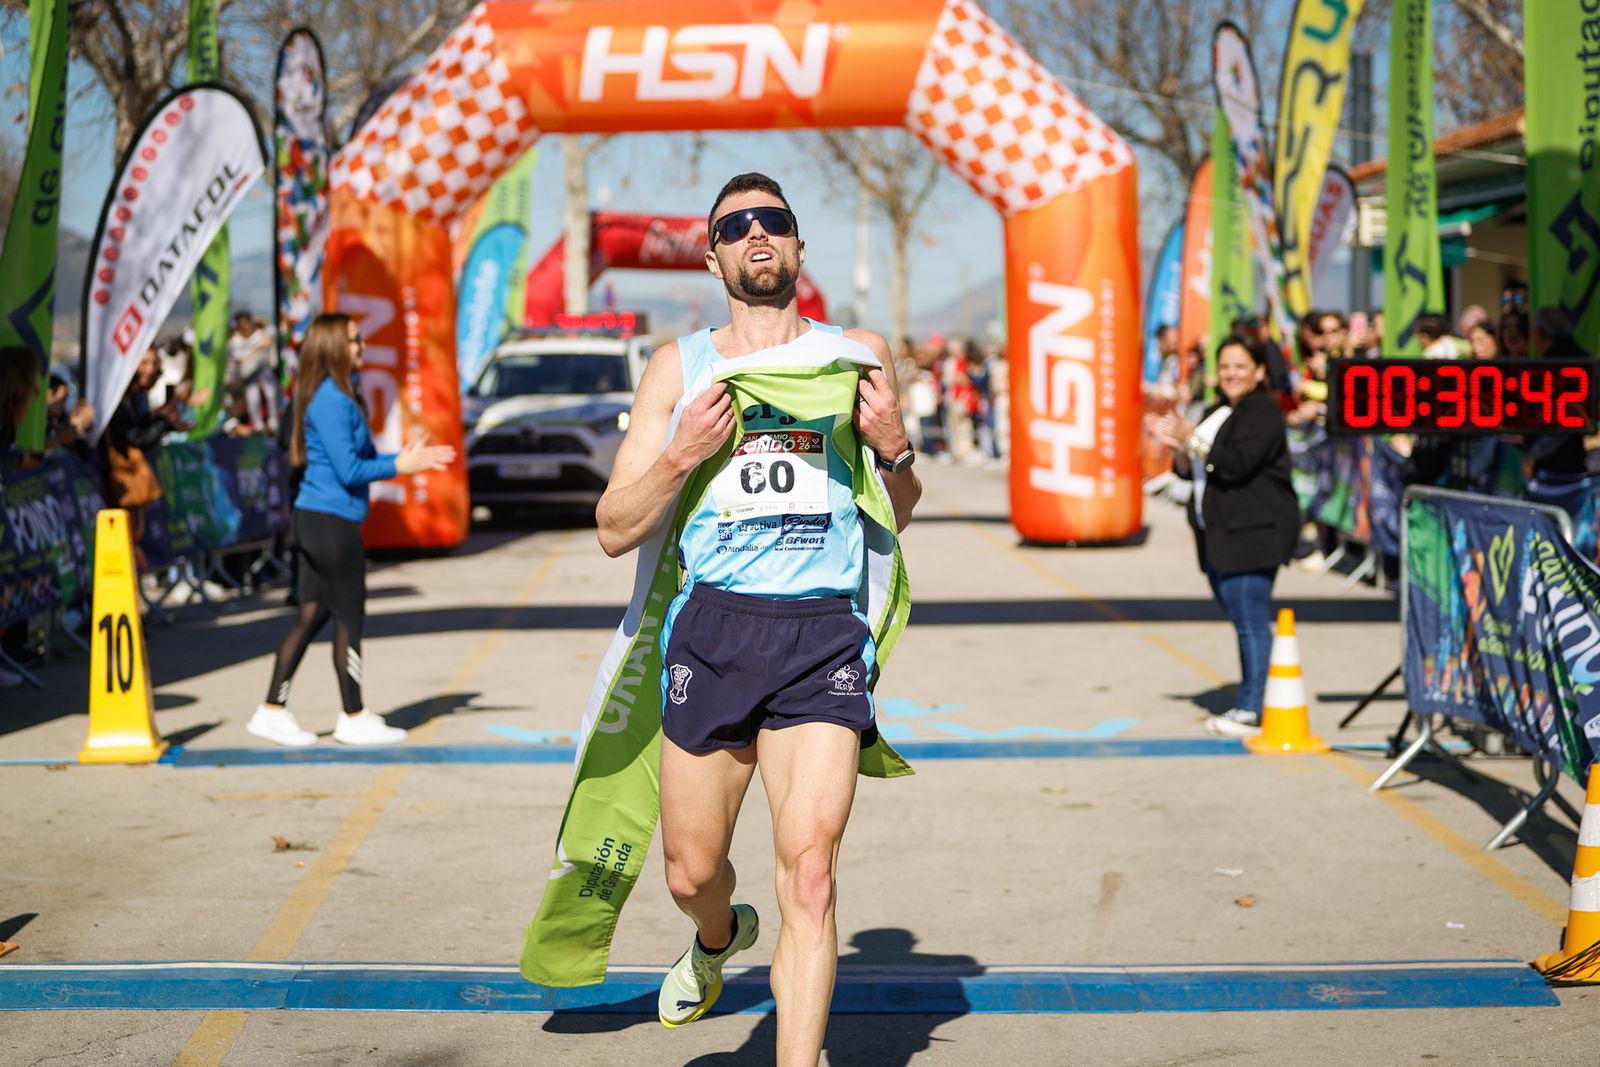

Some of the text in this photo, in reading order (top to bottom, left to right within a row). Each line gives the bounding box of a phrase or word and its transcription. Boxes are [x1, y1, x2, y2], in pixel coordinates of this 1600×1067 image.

[579, 23, 832, 102] HSN
[139, 163, 244, 307] DATACOL
[1027, 279, 1096, 498] HSN
[1343, 365, 1589, 427] 00:30:42
[796, 435, 808, 443] 20
[798, 442, 811, 450] 26
[740, 460, 795, 494] 60
[99, 614, 134, 693] 10
[578, 837, 615, 898] Diputación
[596, 889, 613, 901] de
